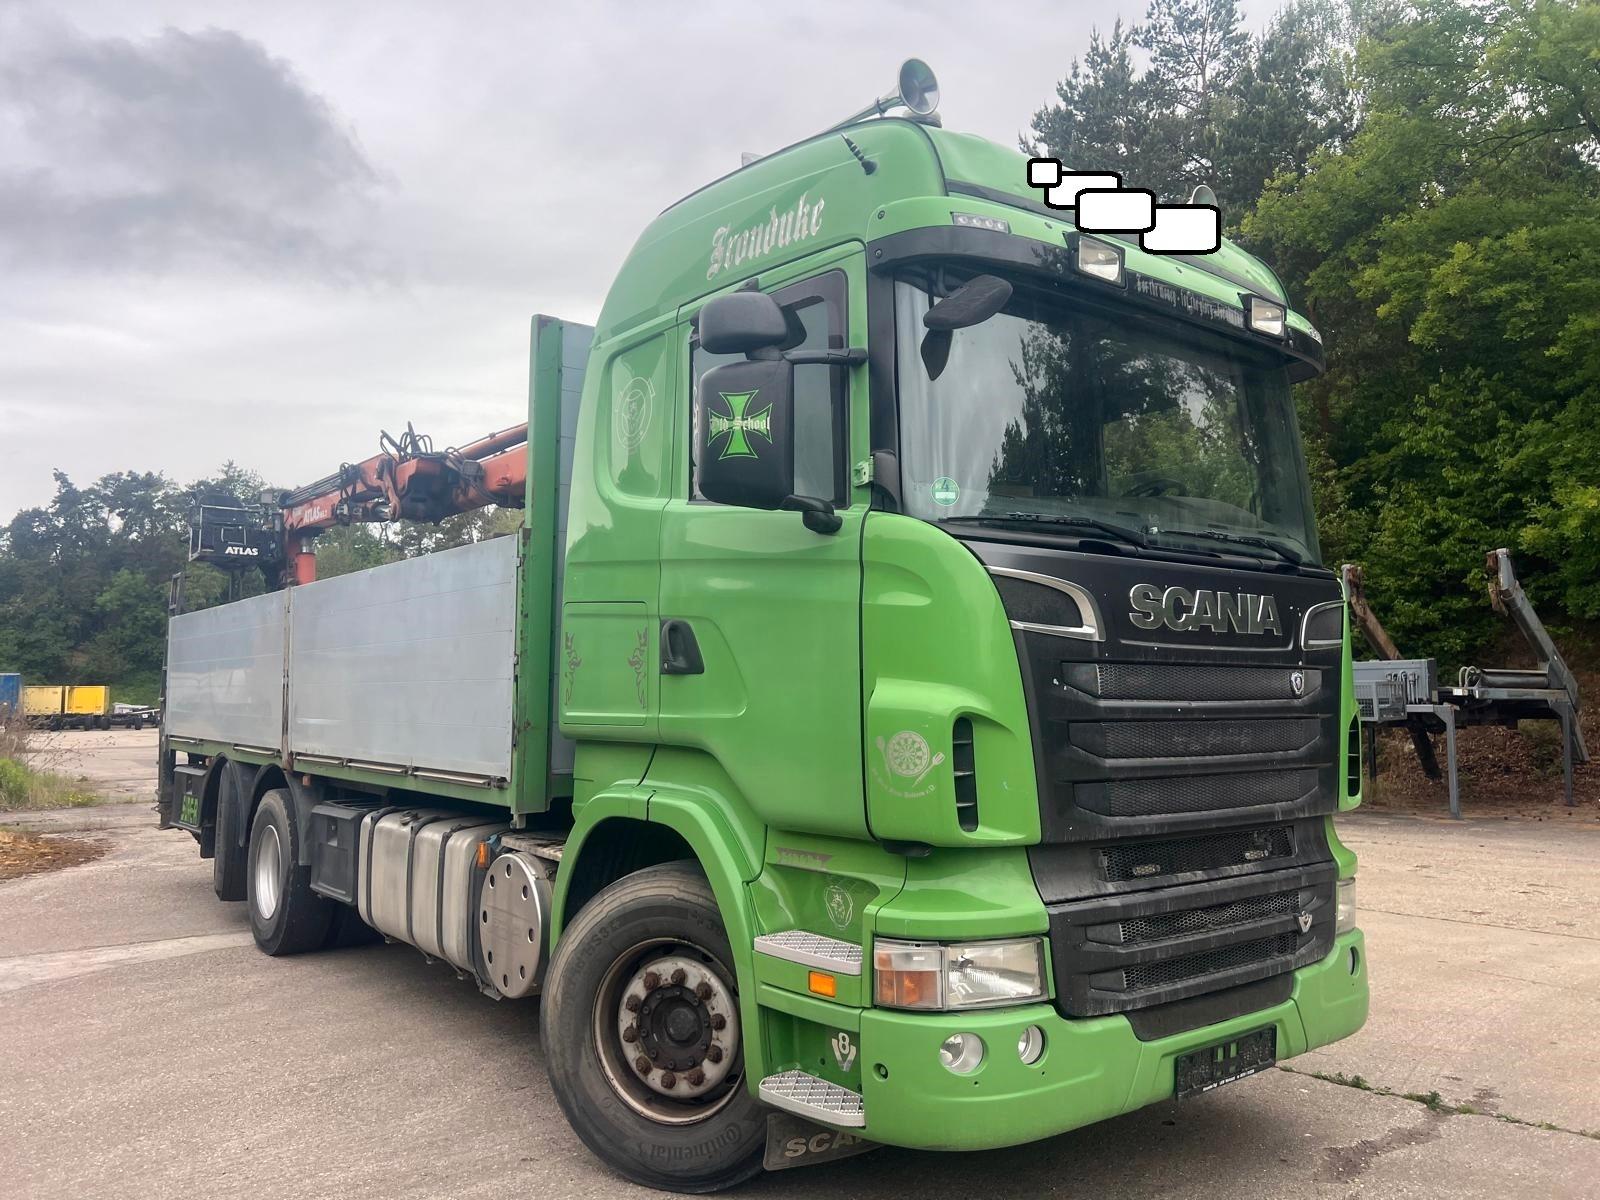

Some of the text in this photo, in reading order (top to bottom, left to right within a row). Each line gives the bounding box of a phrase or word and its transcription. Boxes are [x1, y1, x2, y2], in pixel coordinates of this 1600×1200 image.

[225, 547, 259, 556] ATLAS
[1129, 583, 1283, 636] SCANIA
[831, 1032, 857, 1073] V8
[649, 1122, 743, 1168] Continental
